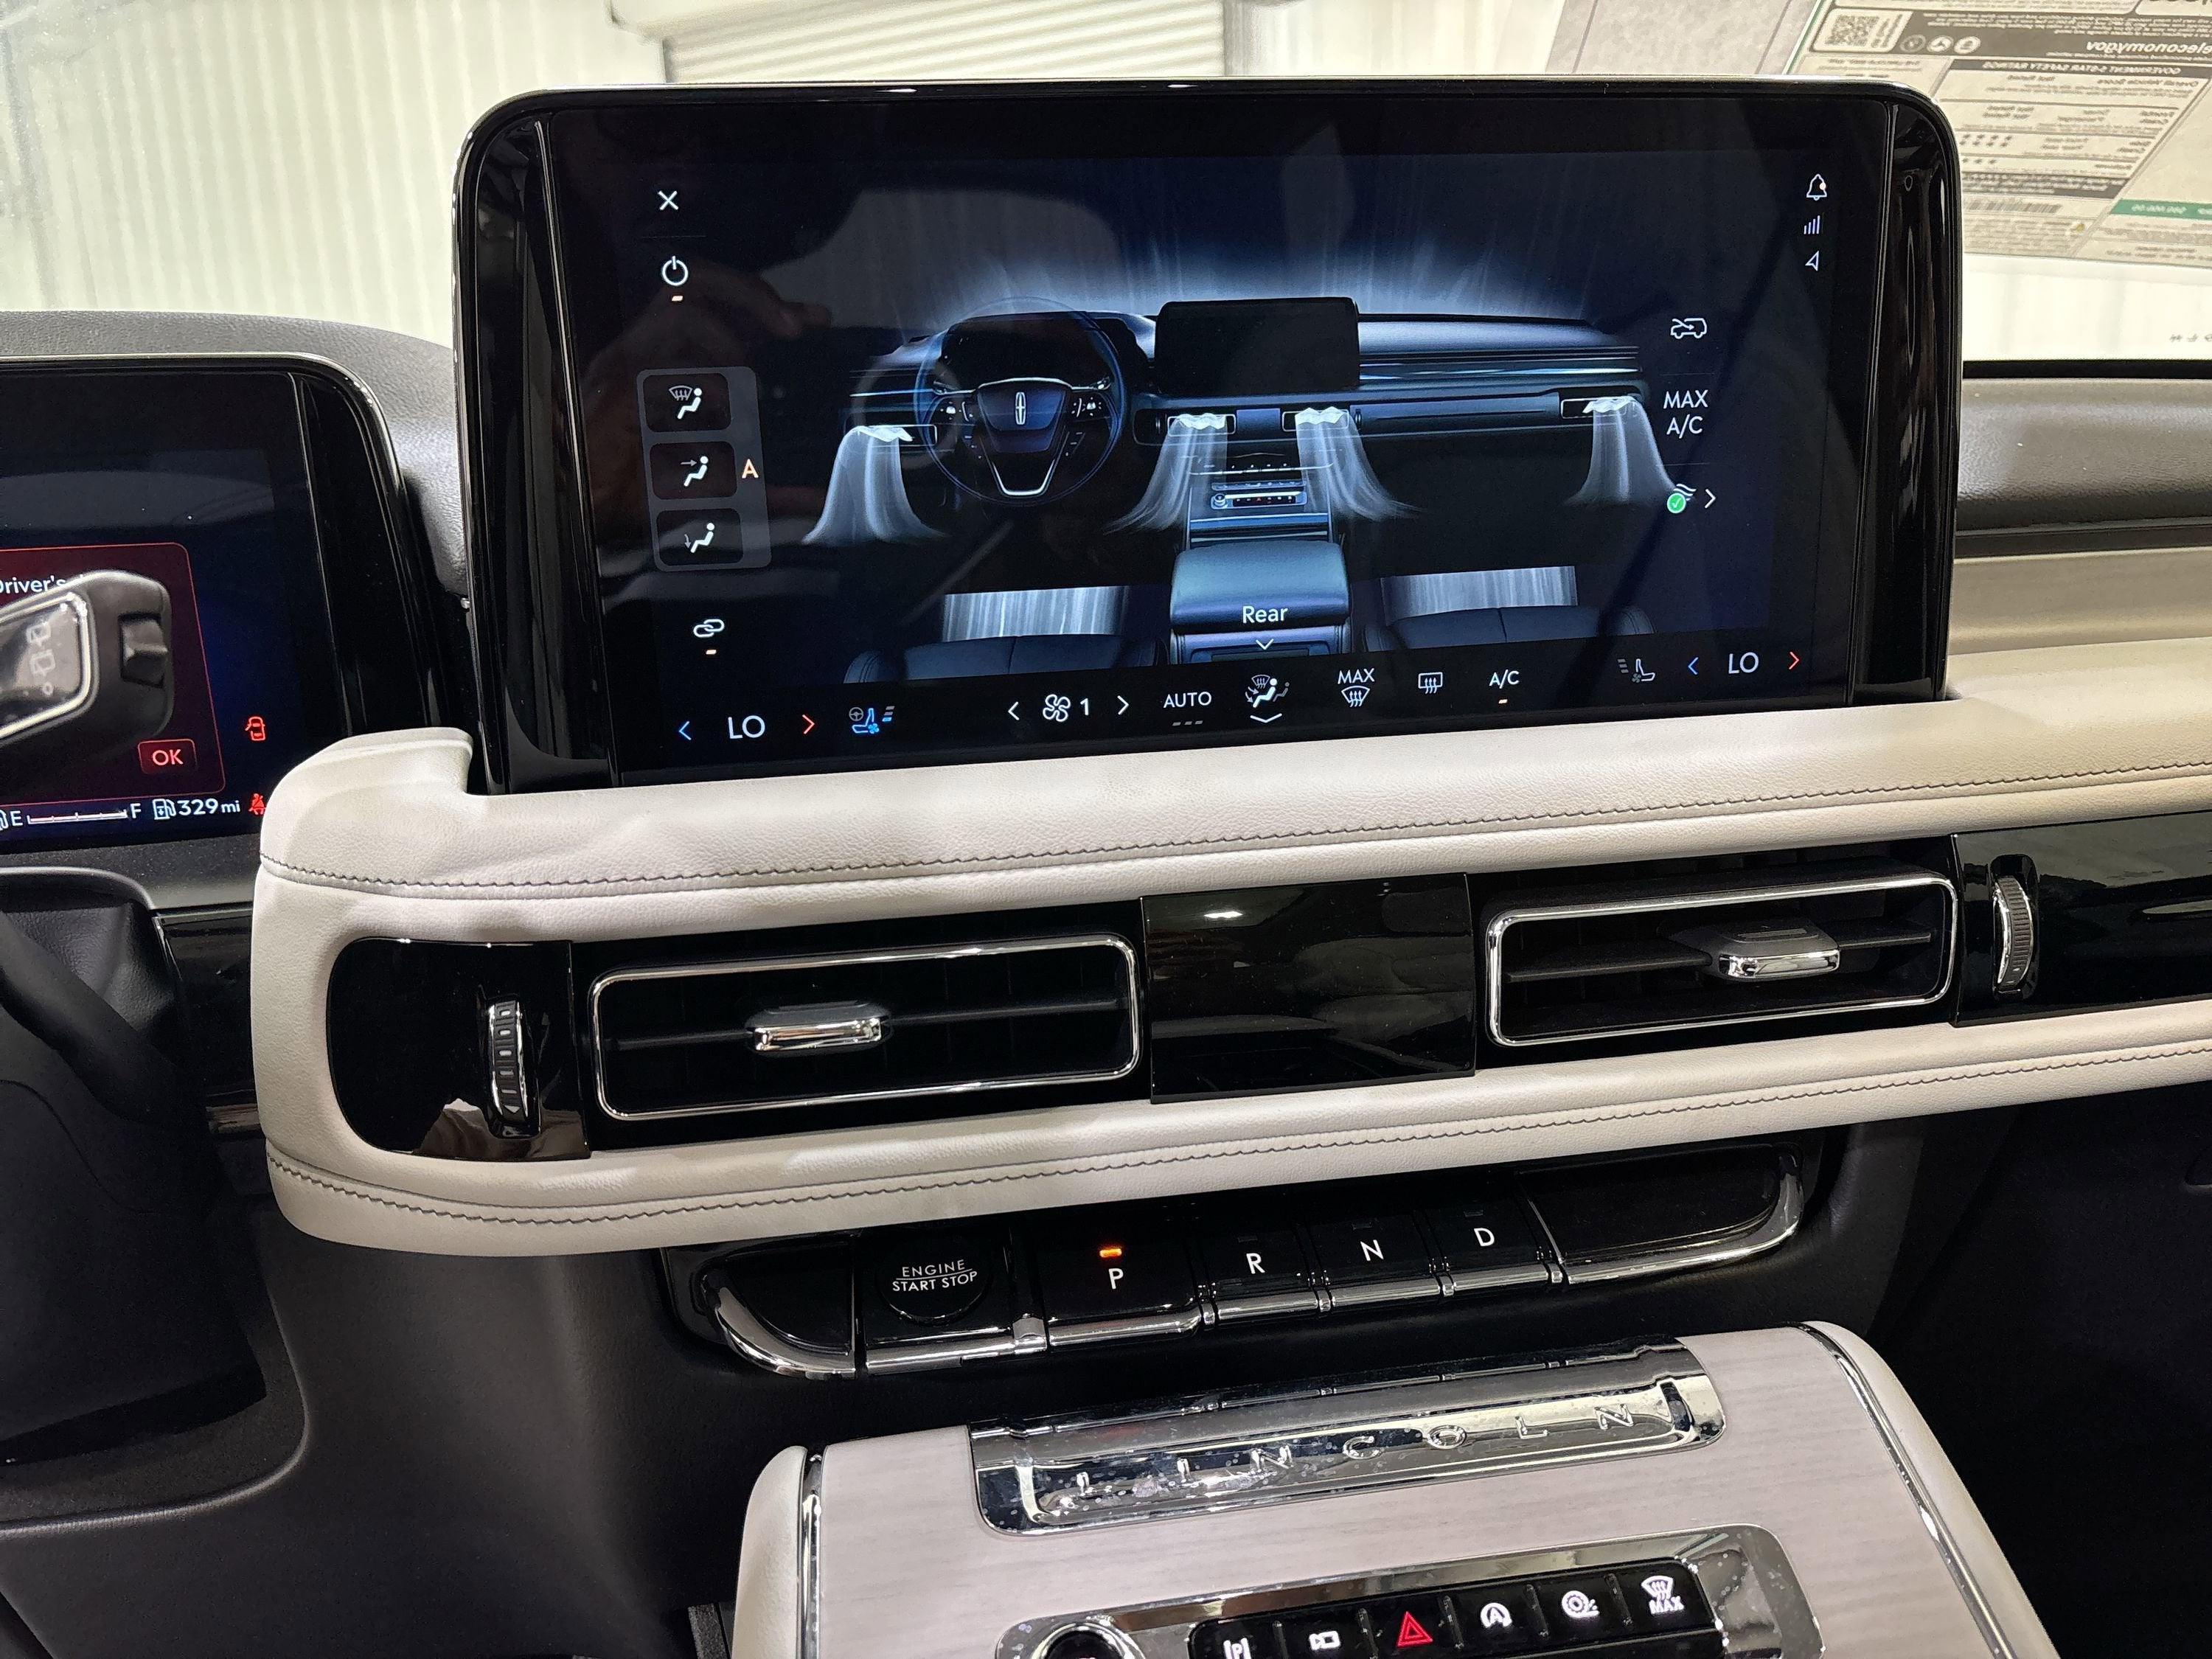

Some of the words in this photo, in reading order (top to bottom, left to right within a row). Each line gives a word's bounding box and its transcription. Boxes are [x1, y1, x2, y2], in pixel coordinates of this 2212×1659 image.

[1663, 389, 1708, 409] MAX
[1666, 414, 1703, 439] A/C
[742, 459, 759, 479] A
[1242, 605, 1288, 624] Rear
[1728, 652, 1759, 675] LO
[1338, 668, 1375, 684] MAX
[1489, 669, 1520, 688] A/C
[1080, 698, 1090, 716] 1
[1163, 692, 1211, 709] AUTO
[728, 715, 765, 740] LO
[152, 749, 184, 766] OK
[130, 804, 142, 819] F
[178, 799, 219, 816] 329
[220, 799, 240, 814] mi
[11, 810, 24, 827] E
[1473, 1227, 1495, 1248] D
[1362, 1239, 1384, 1262] N
[901, 1259, 967, 1279] ENGINE
[1246, 1252, 1265, 1275] R
[892, 1277, 938, 1293] START
[941, 1270, 978, 1289] STOP
[1108, 1267, 1124, 1290] P
[1077, 1402, 1635, 1497] LINCOLN
[1649, 1594, 1683, 1615] MAX
